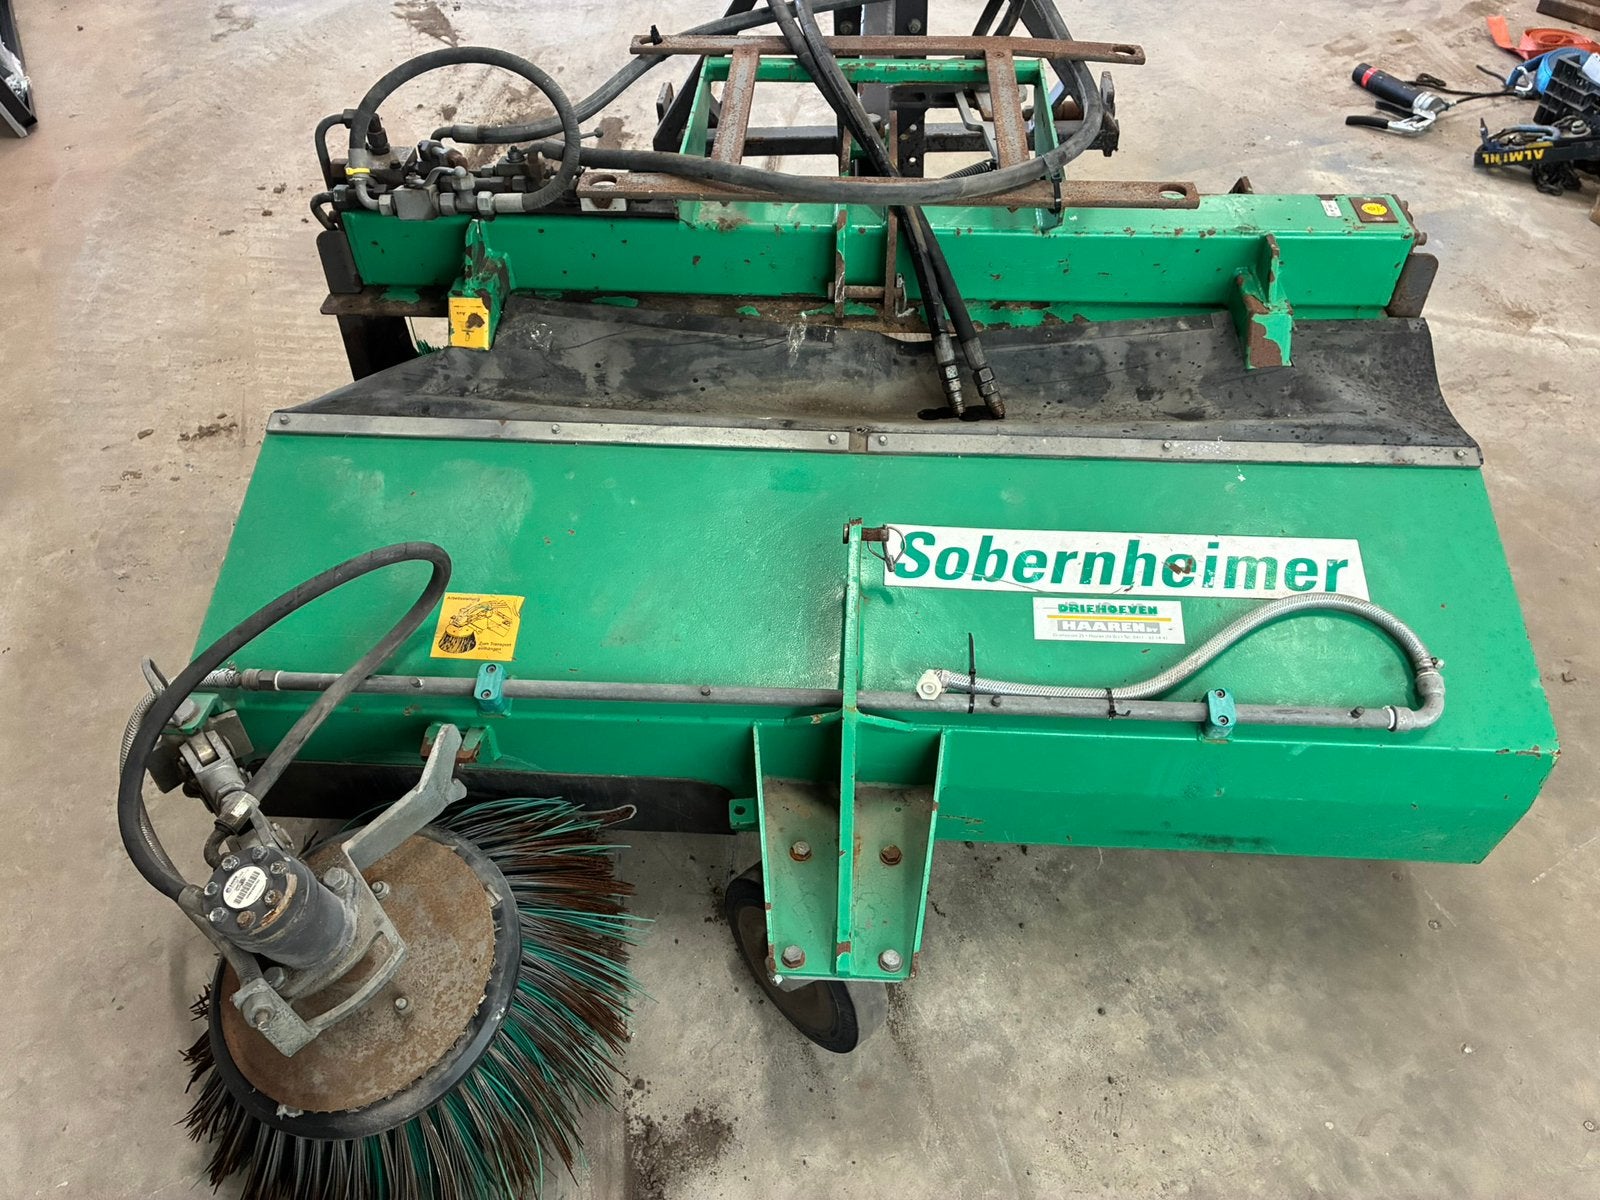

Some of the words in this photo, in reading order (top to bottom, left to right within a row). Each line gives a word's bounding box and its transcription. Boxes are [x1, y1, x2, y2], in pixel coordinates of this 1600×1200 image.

[894, 531, 1349, 593] Sobernheimer
[1057, 603, 1159, 615] DRIEHOEVEN
[1062, 620, 1146, 632] HAAREN
